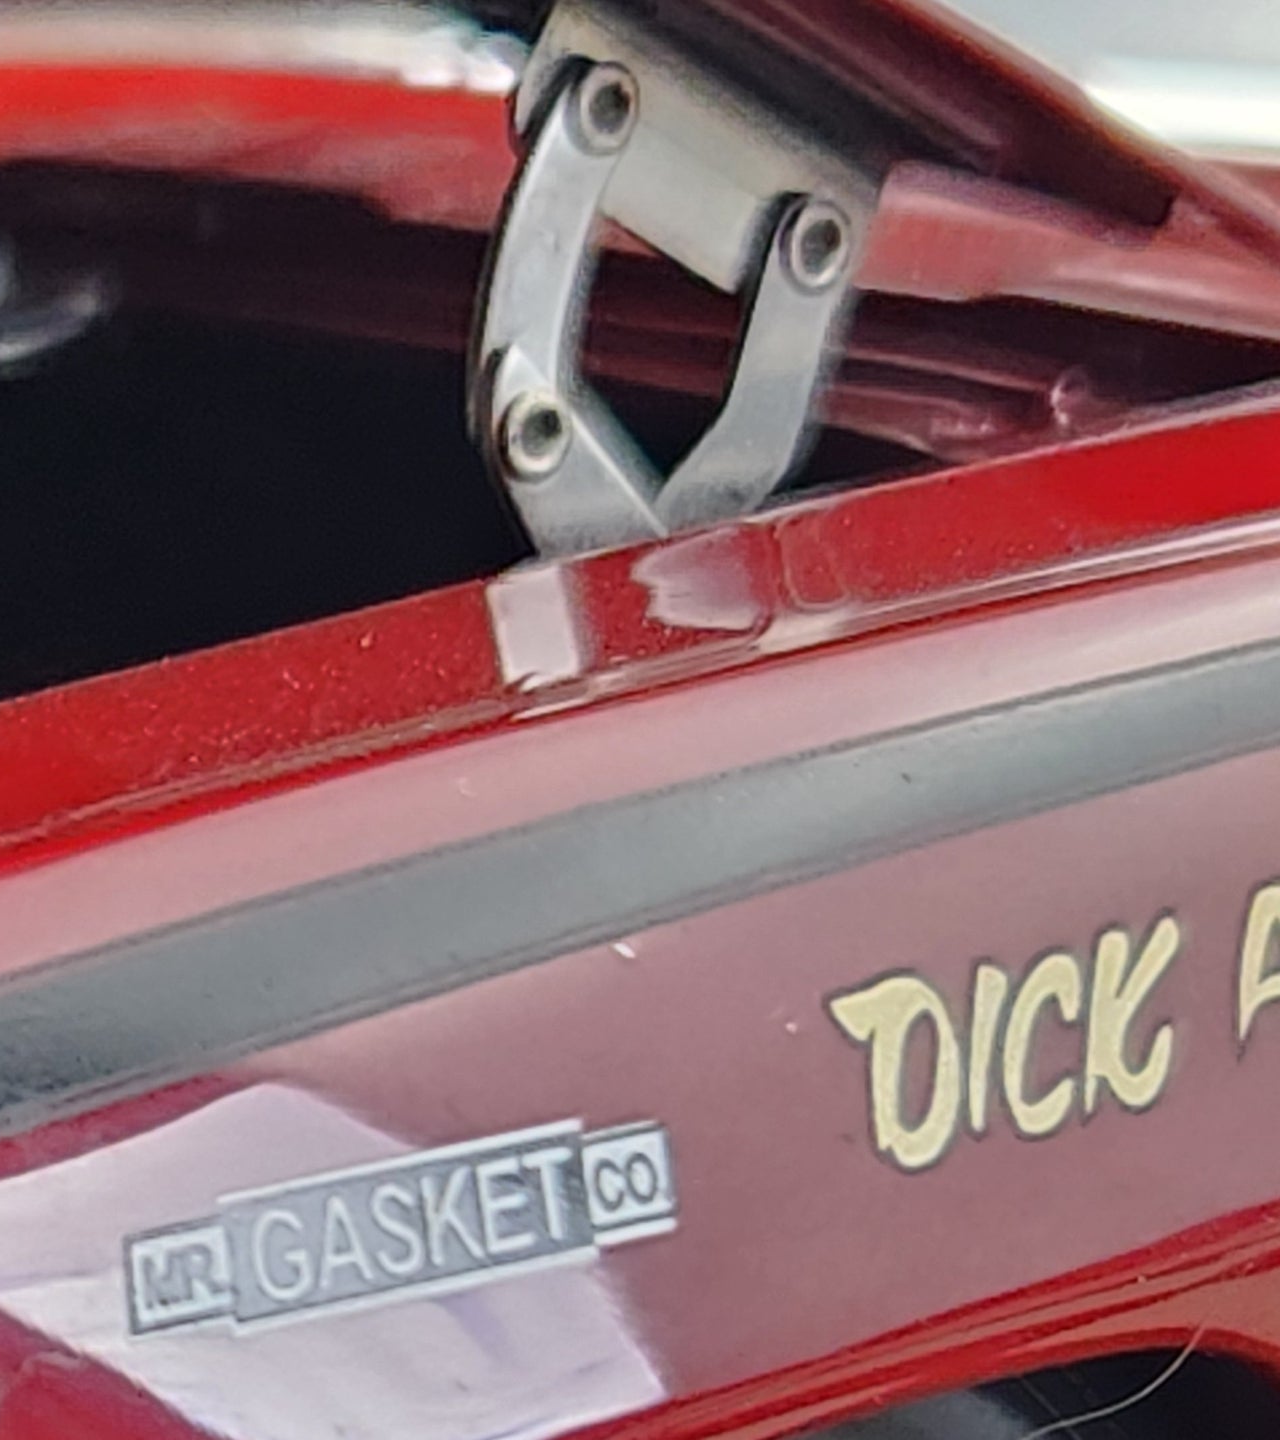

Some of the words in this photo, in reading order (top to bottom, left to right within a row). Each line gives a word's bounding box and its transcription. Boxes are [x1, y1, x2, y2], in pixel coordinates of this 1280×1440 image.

[826, 916, 1181, 1170] DICK
[250, 1147, 573, 1301] GASKET
[593, 1151, 659, 1214] CO
